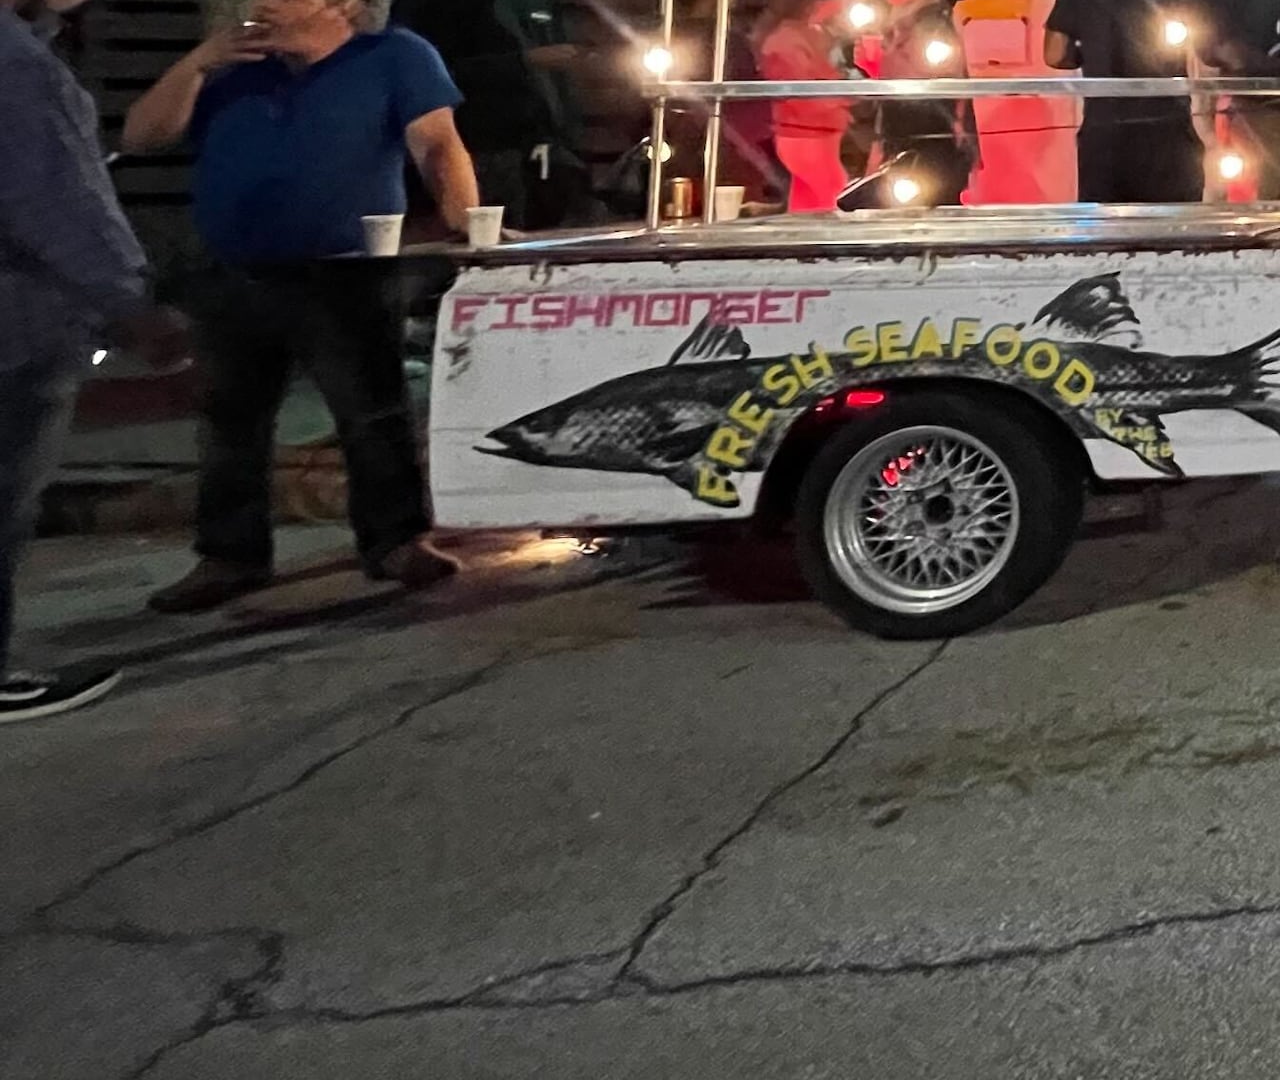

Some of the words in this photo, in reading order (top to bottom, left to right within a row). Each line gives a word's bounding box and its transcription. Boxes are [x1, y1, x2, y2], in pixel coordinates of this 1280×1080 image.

[451, 290, 831, 331] FISHMONGER
[694, 341, 834, 508] FRESH
[843, 317, 1097, 407] SEAFOOD
